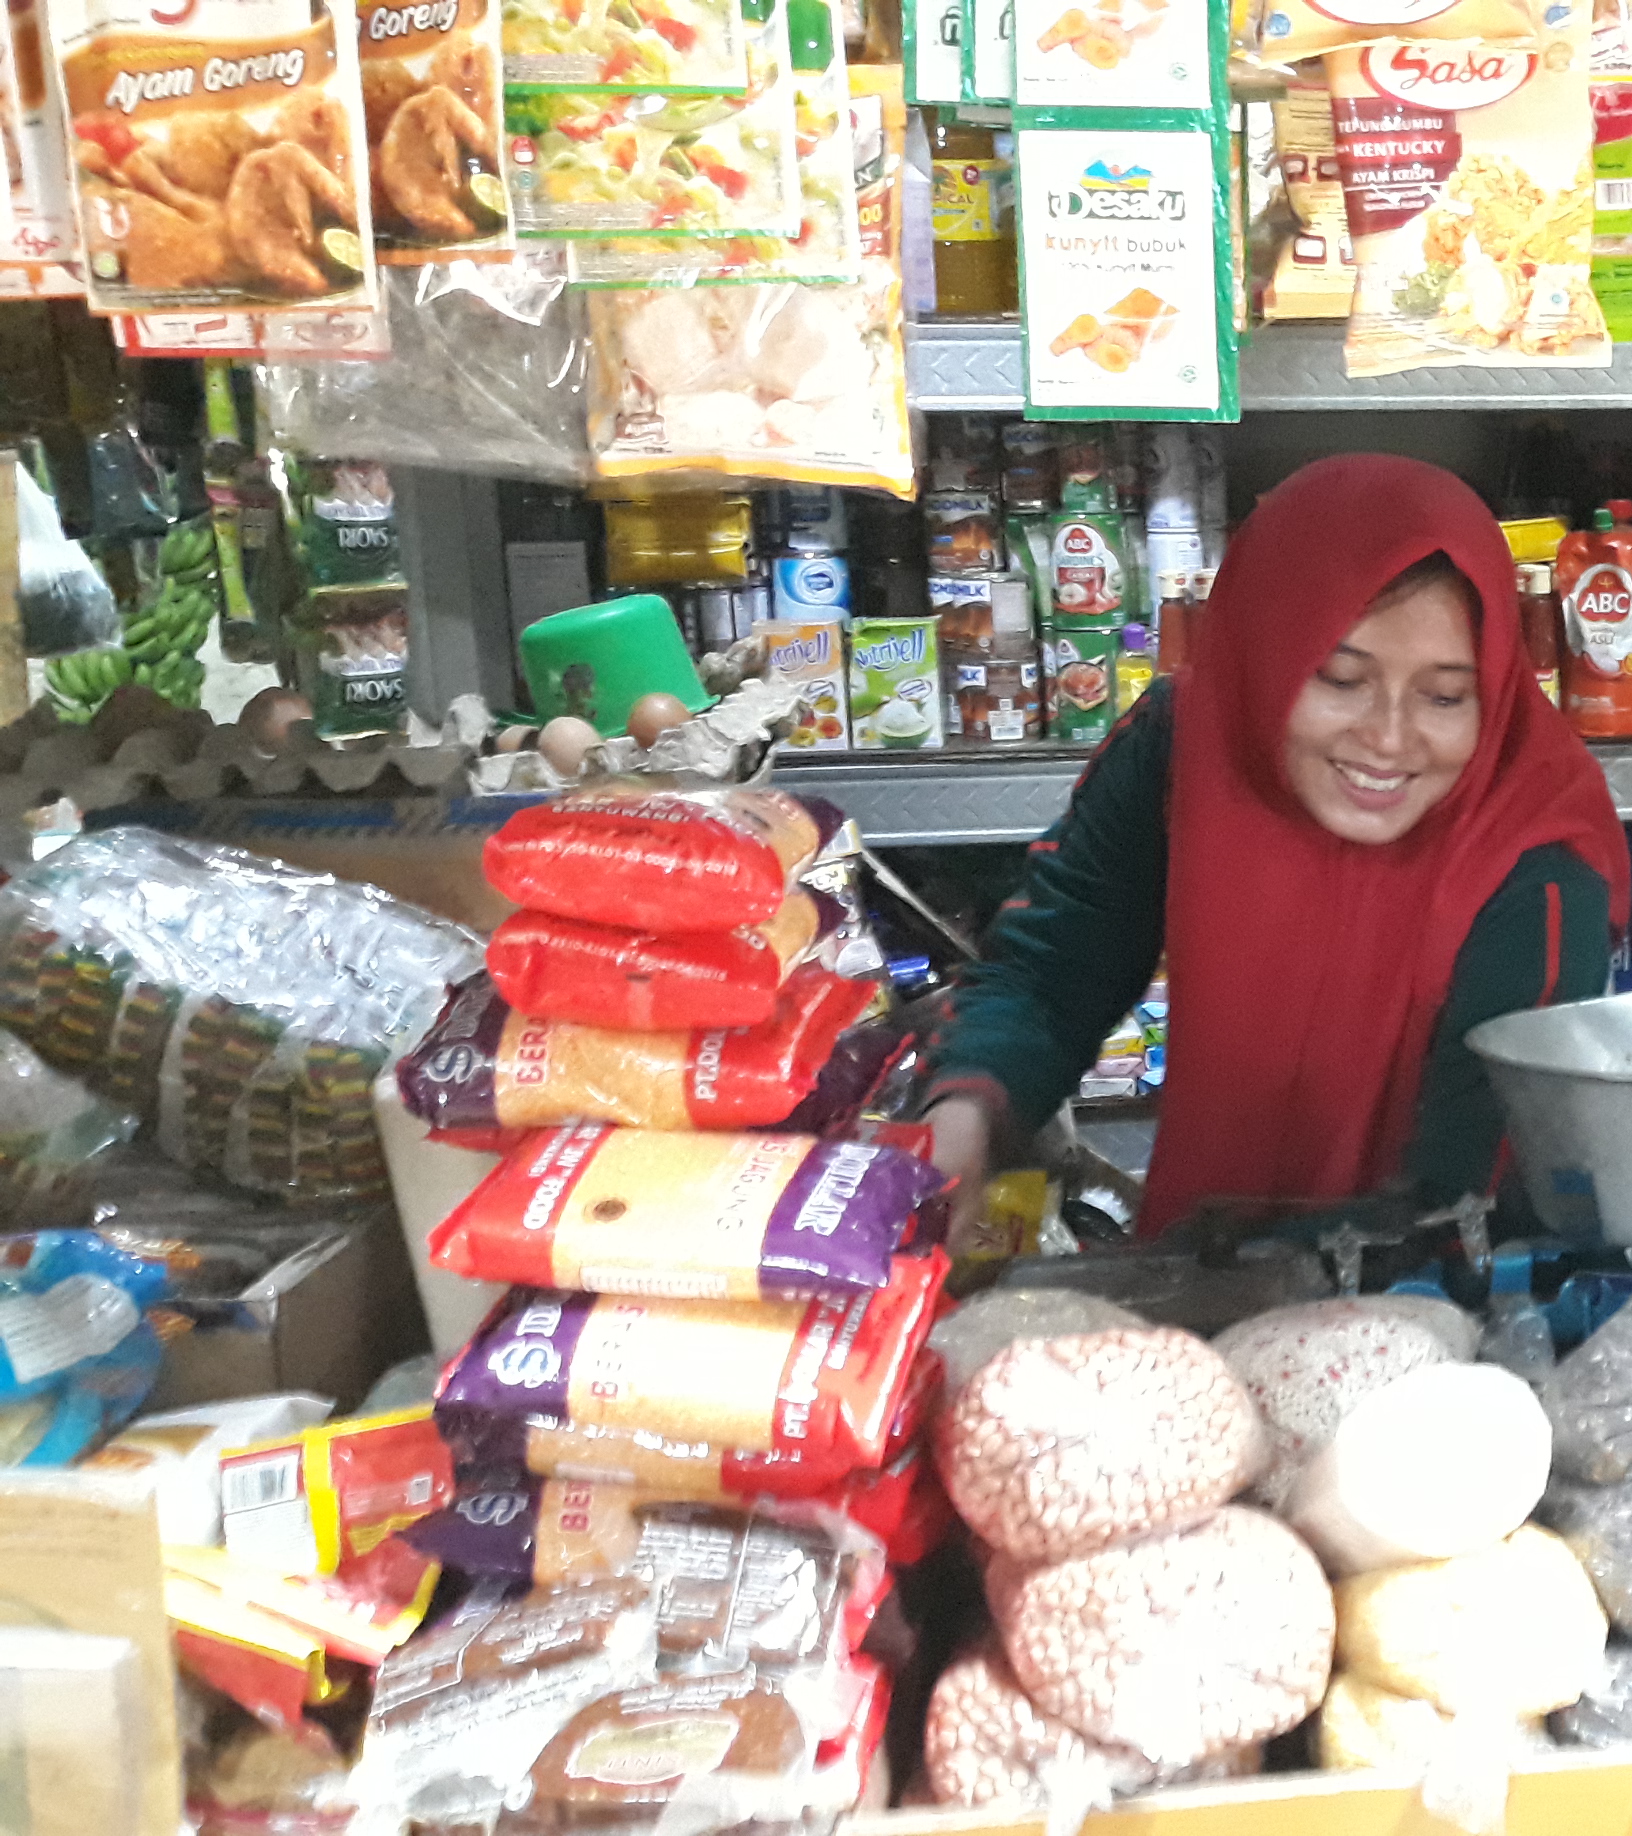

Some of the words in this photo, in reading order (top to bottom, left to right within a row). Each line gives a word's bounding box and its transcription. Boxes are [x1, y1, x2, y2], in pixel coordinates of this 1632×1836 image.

[1390, 46, 1506, 90] Sasa
[105, 64, 195, 115] Ayam
[202, 48, 304, 93] Goreng
[1352, 141, 1446, 157] KENTUCKY
[1047, 189, 1187, 222] Desaku
[1127, 236, 1187, 252] bubuk
[337, 526, 389, 549] SAORI
[1580, 592, 1630, 614] ABC
[854, 627, 926, 671] Nutrijell
[346, 679, 404, 702] SAORI
